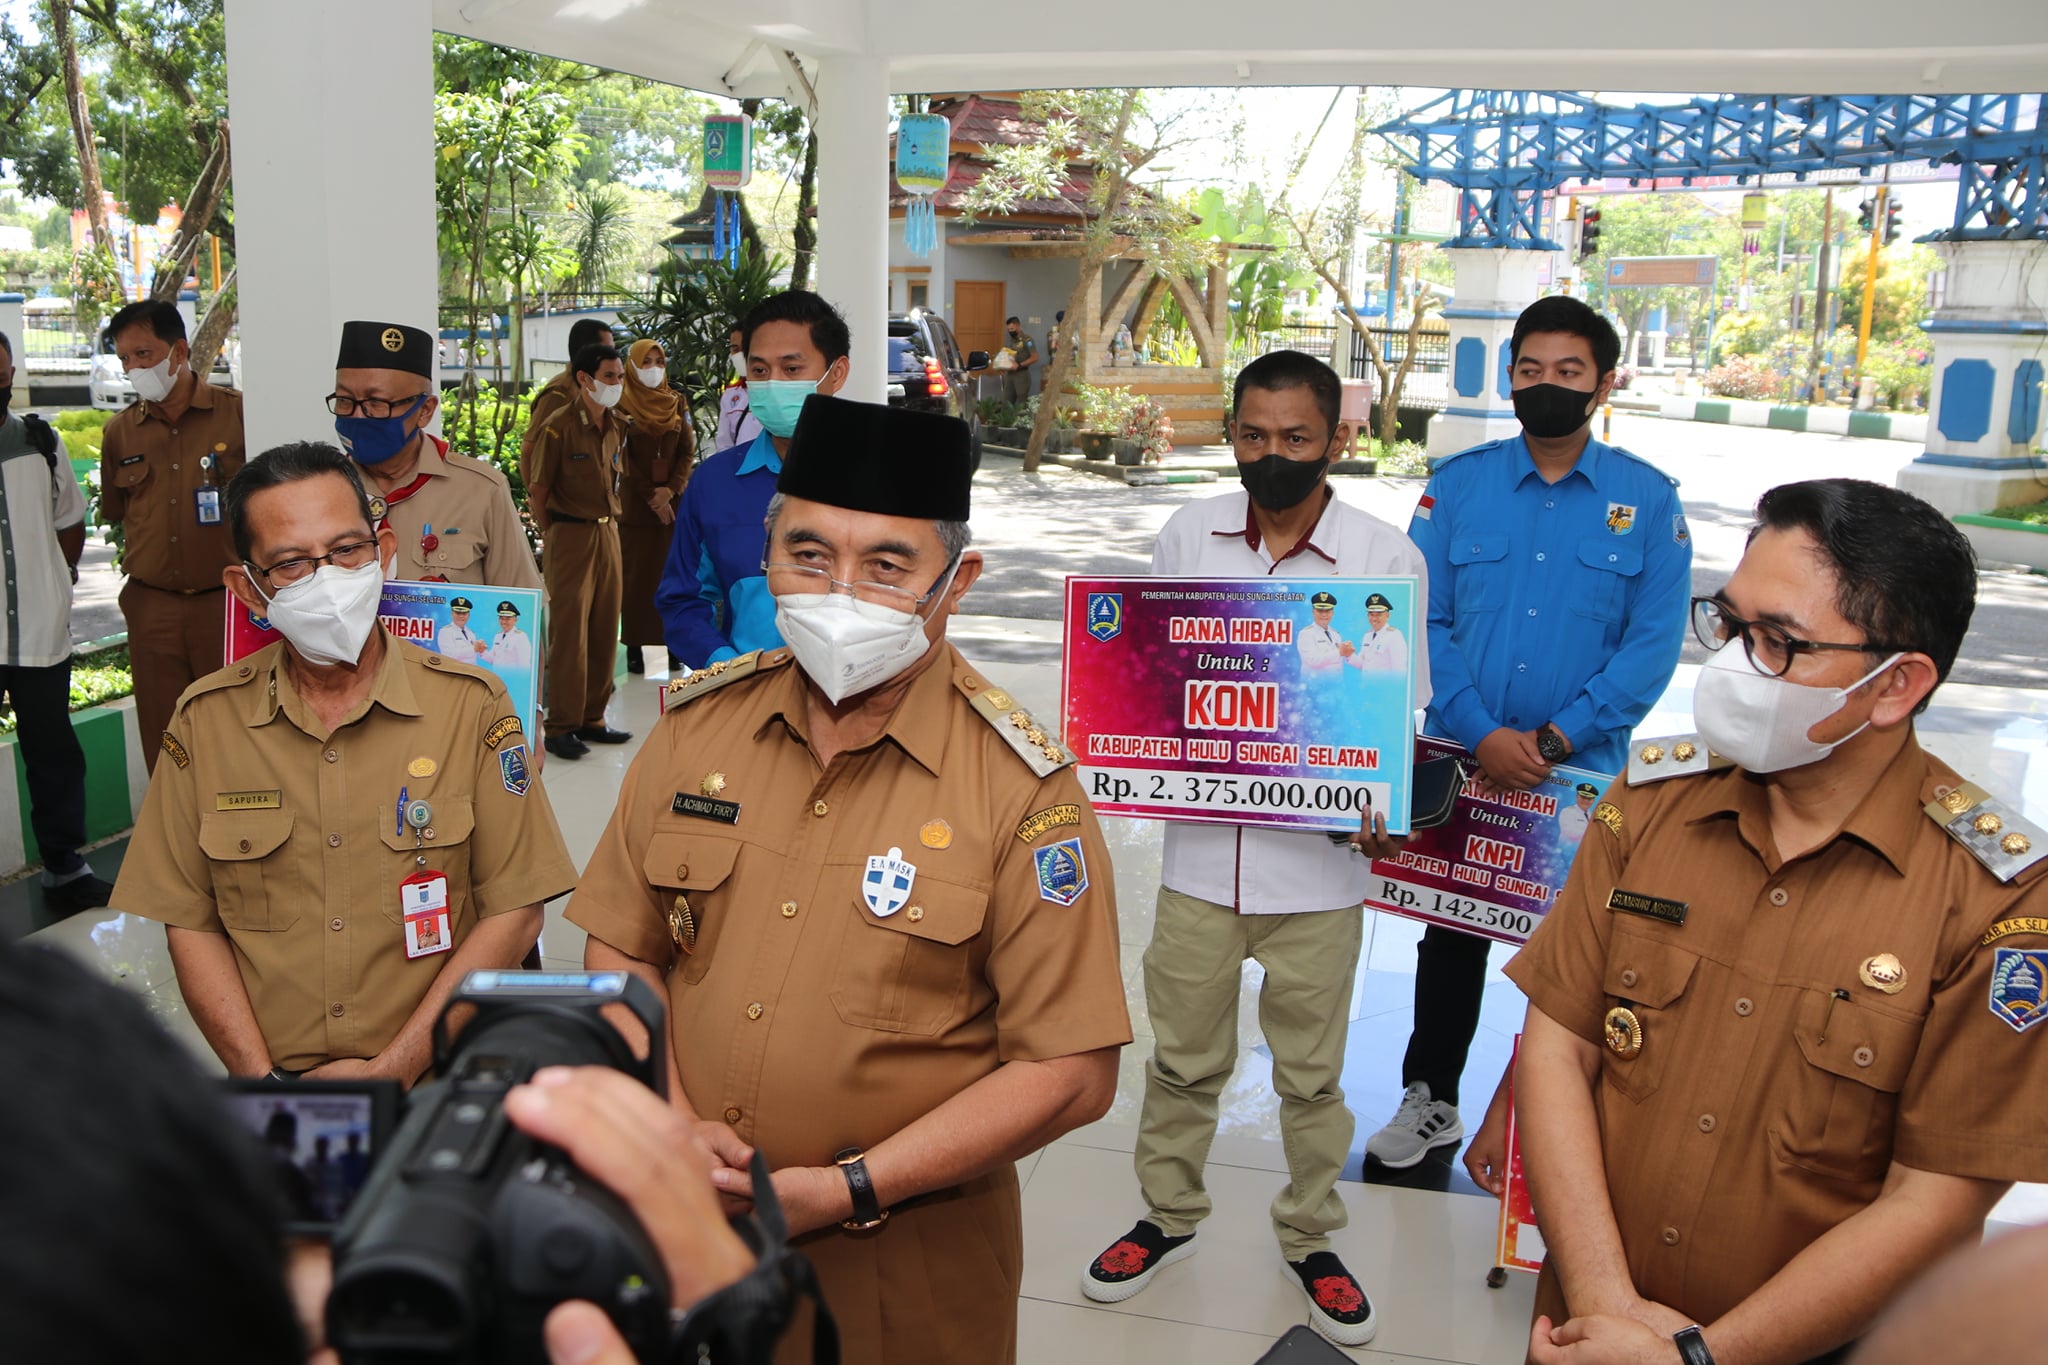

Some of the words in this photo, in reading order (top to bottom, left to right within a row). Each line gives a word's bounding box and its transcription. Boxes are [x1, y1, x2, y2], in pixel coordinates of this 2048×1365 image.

[1141, 591, 1184, 600] PEMERINTAH
[1185, 592, 1225, 600] KABUPATEN
[1226, 592, 1244, 601] HULU
[1246, 593, 1273, 601] SUNGAI
[1275, 593, 1306, 601] SELATAN
[380, 616, 434, 640] HIBAH
[1170, 618, 1226, 643] DANA
[1230, 619, 1292, 645] HIBAH
[1197, 653, 1254, 672] Untuk
[1186, 681, 1278, 731] KONI
[1089, 735, 1180, 760] KABUPATEN
[1187, 738, 1231, 762] HULU
[1237, 740, 1299, 765] SUNGAI
[1308, 744, 1380, 769] SELATAN
[228, 796, 269, 805] SAPUTRA
[1092, 772, 1138, 802] Rp.
[713, 804, 736, 818] FIKRY
[1501, 788, 1558, 816] HIBAH
[1018, 806, 1063, 834] PEMERINTAH
[1042, 815, 1078, 829] SELATAN
[1470, 807, 1520, 830] Untuk
[1465, 834, 1526, 873] KNPI
[1381, 880, 1421, 907] Rp.
[1452, 864, 1491, 887] HULU
[1495, 875, 1549, 902] SUNGAI
